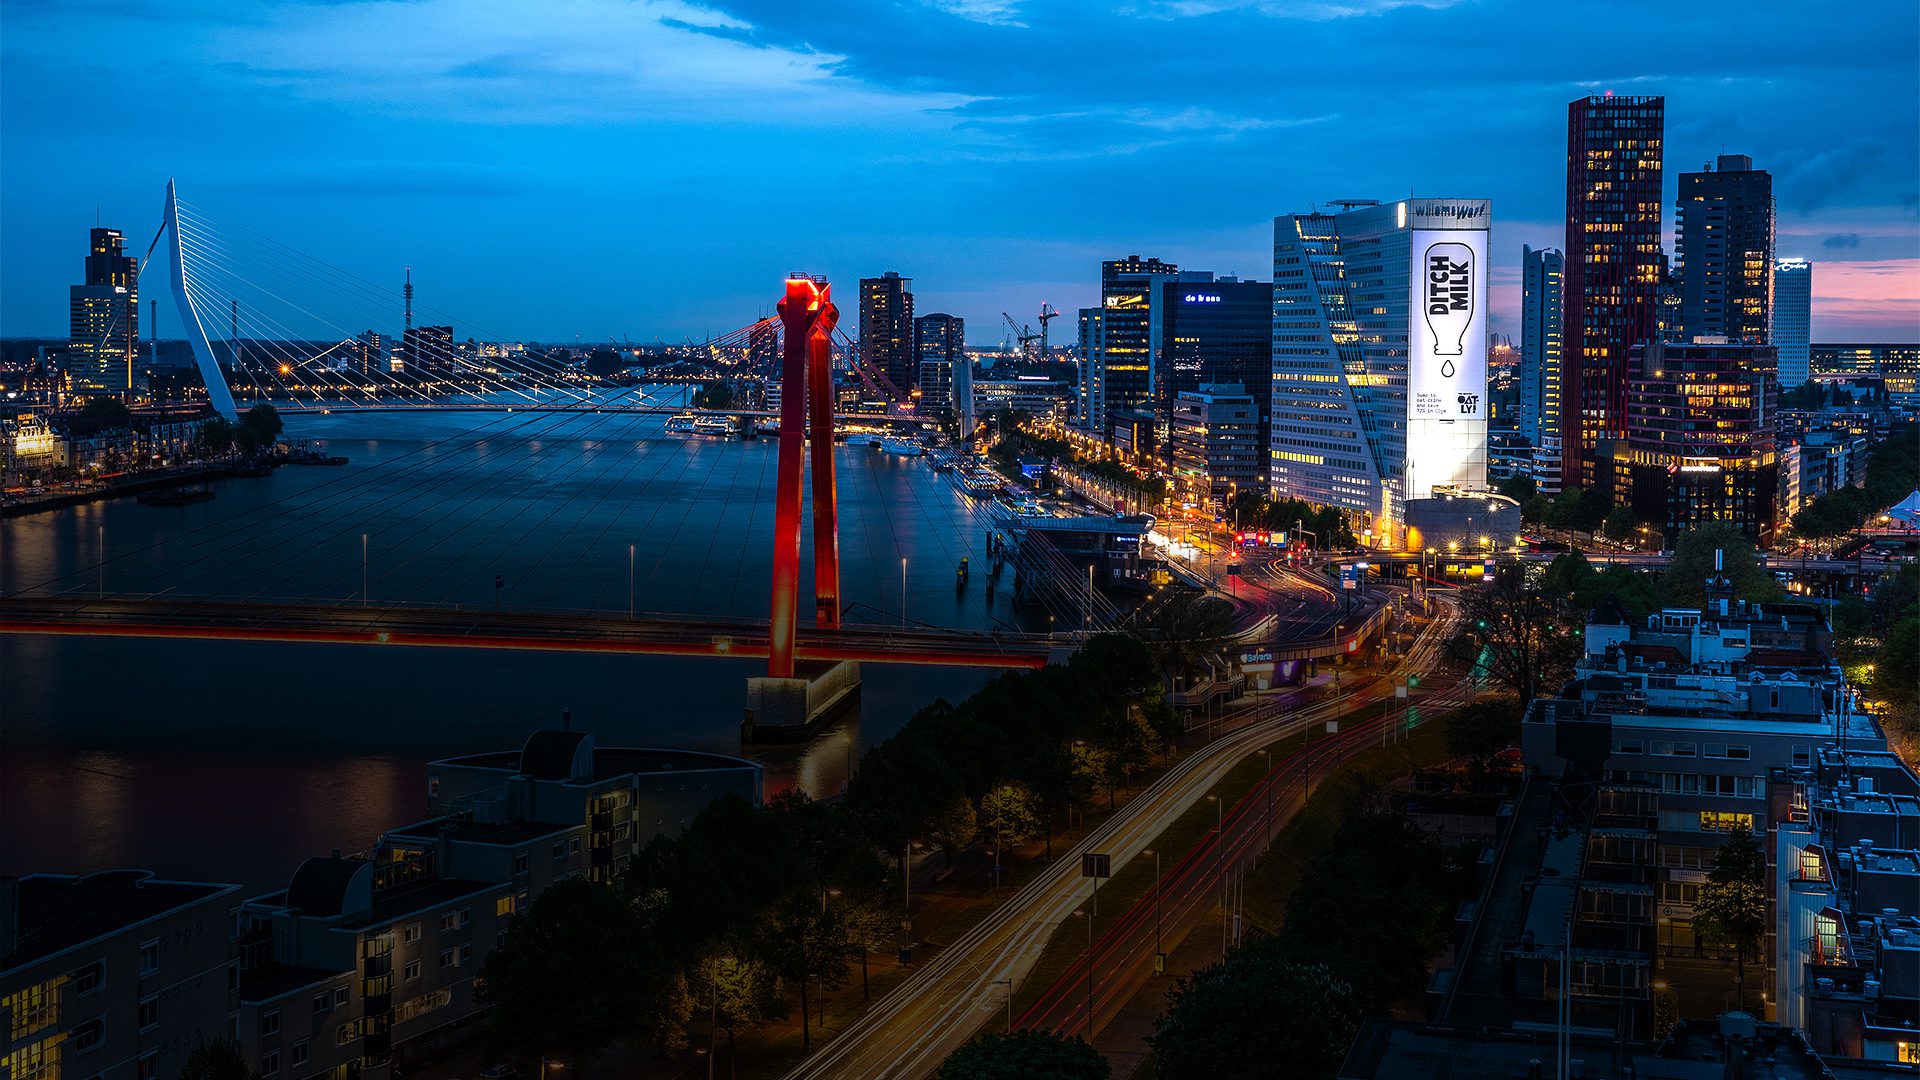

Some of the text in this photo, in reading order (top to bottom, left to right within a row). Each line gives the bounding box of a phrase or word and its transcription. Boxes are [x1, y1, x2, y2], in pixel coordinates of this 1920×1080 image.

[1429, 256, 1449, 315] DITCH
[1449, 260, 1469, 311] MILK
[1460, 404, 1476, 414] LY!
